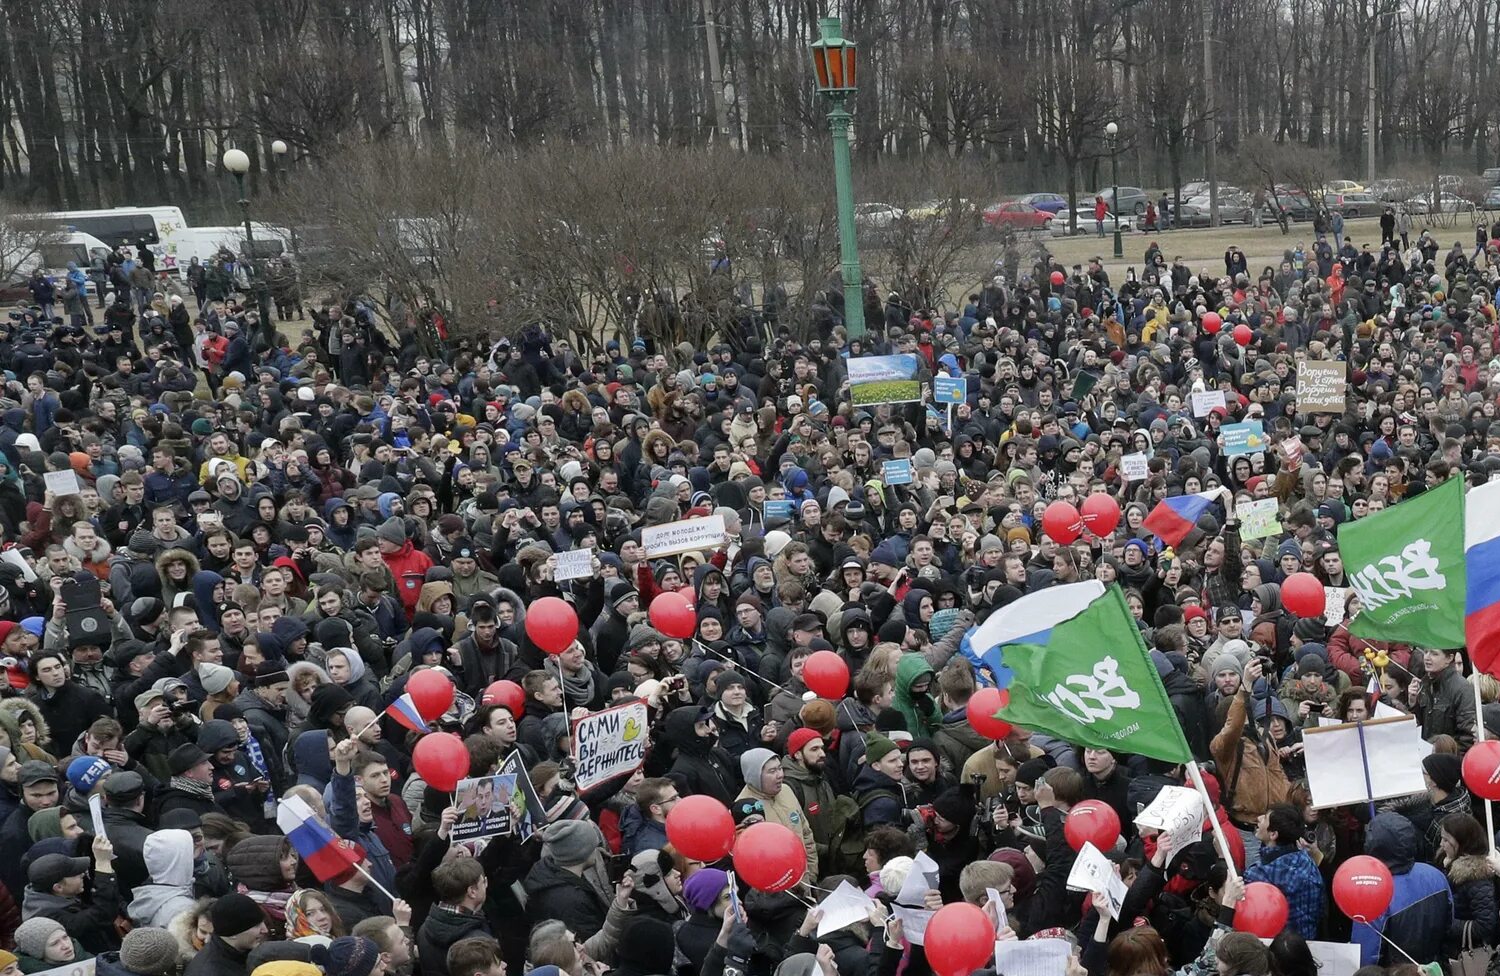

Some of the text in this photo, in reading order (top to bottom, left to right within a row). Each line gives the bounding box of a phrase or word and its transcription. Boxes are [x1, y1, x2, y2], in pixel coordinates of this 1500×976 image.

[669, 537, 689, 546] ВЫЗОВ
[578, 712, 620, 743] САМИ
[576, 742, 645, 783] ДЕРЖИТЕСЬ
[579, 741, 599, 760] ВЫ
